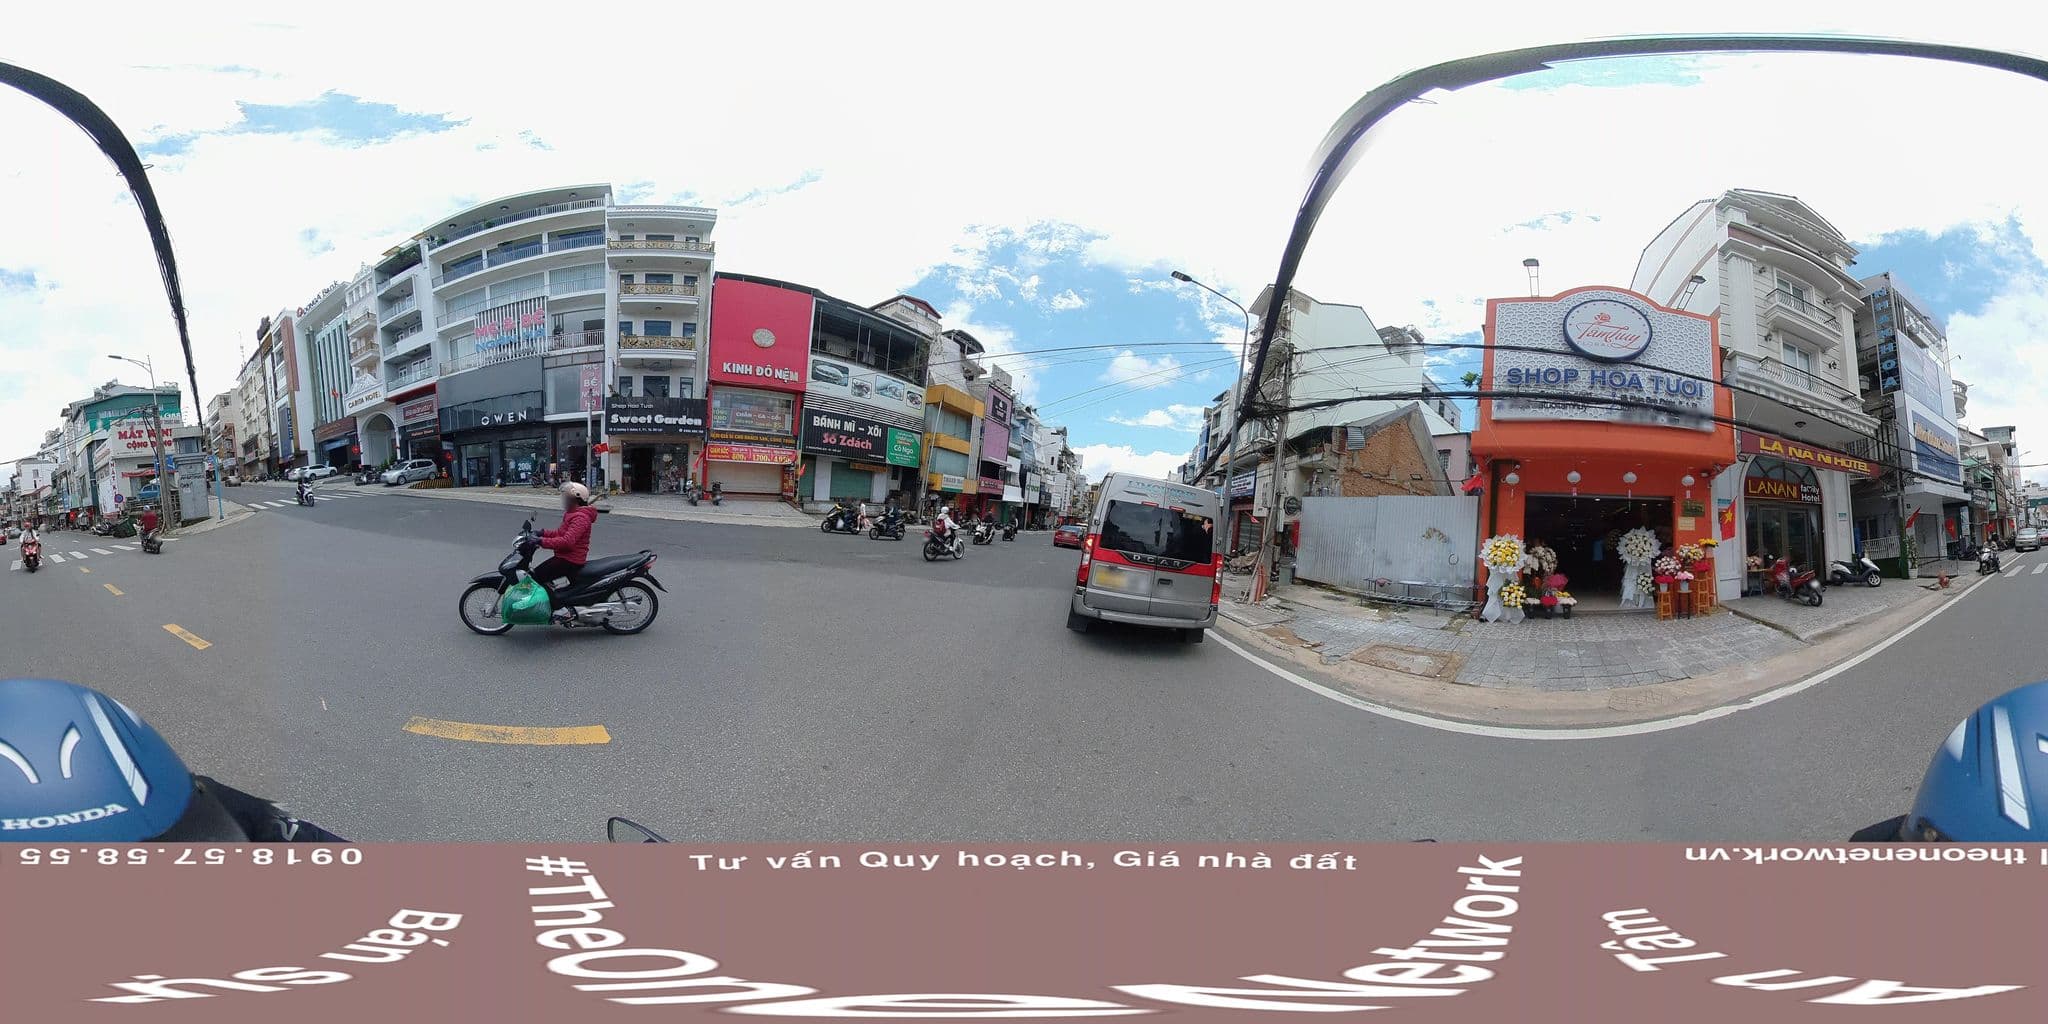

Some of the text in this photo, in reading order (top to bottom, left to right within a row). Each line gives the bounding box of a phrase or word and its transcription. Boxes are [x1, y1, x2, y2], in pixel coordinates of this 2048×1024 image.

[322, 280, 338, 298] Bank
[723, 362, 799, 383] KINH ĐÔ NỆM
[1507, 367, 1704, 398] SHOP HOA TƯƠI
[365, 390, 382, 402] HOTEL
[481, 410, 527, 425] OWEN
[611, 413, 702, 425] Sweet Garden
[813, 415, 841, 430] BÁNH
[844, 420, 856, 432] MÌ
[867, 424, 882, 437] XÔI
[118, 424, 144, 440] MẮT
[127, 440, 148, 450] CỘNG
[839, 434, 872, 450] Zdách
[1760, 437, 1784, 453] LA
[1834, 457, 1871, 473] HOTEL
[1748, 479, 1820, 499] LANANI family
[1801, 493, 1820, 502] Hotel
[2, 803, 128, 830] HONDA
